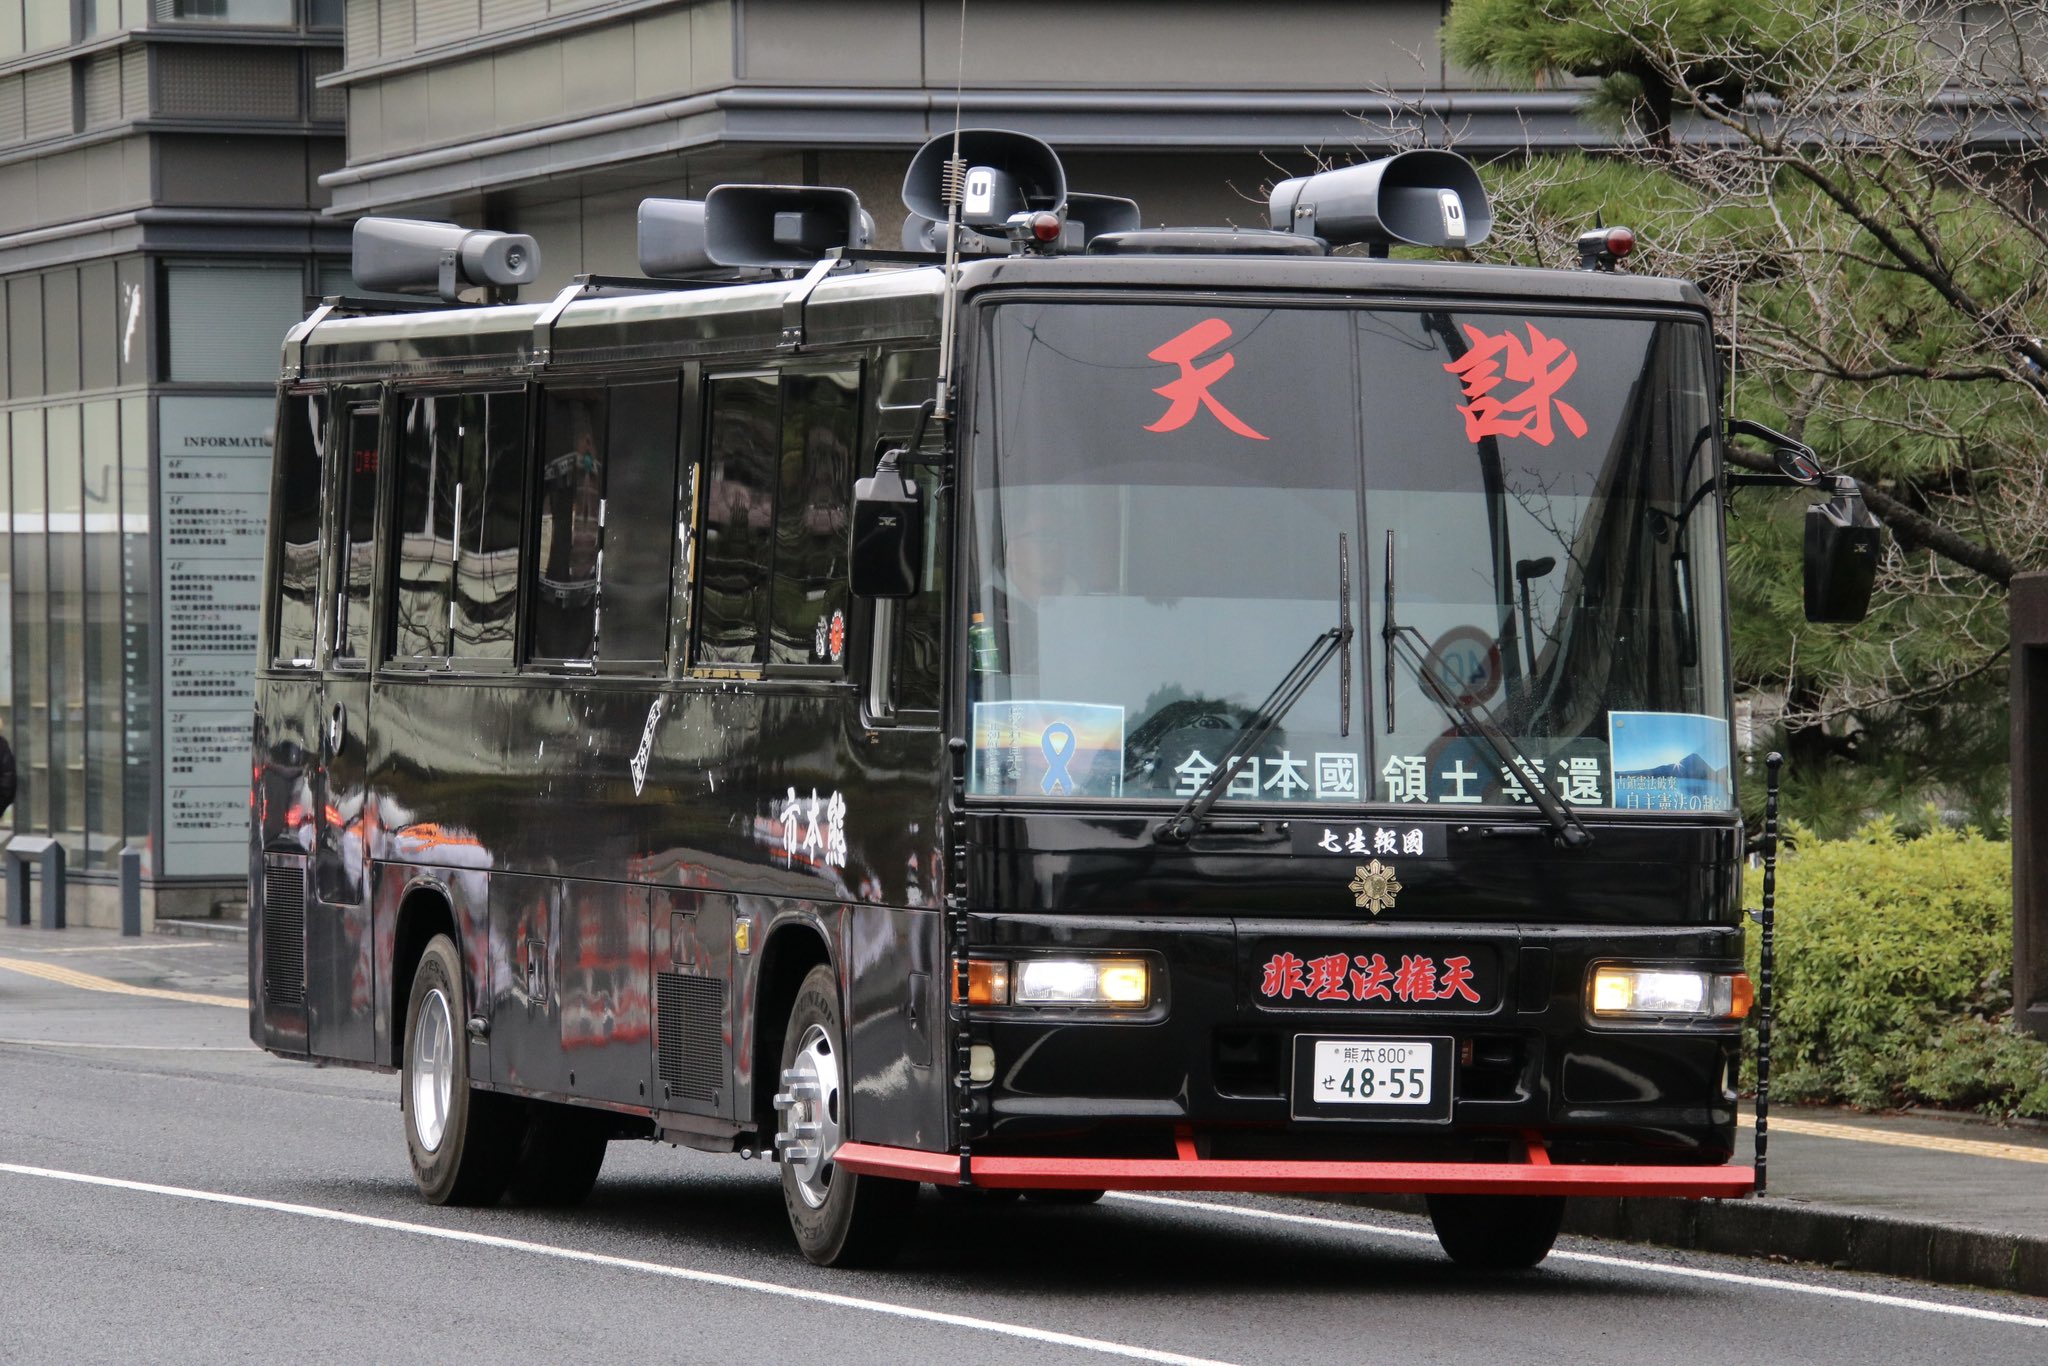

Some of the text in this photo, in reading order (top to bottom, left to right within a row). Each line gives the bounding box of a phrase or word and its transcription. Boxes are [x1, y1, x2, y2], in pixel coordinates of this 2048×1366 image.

[1142, 317, 1588, 446] 天 誅
[184, 437, 272, 447] INFORMATI
[1322, 1068, 1425, 1098] せ 48-55
